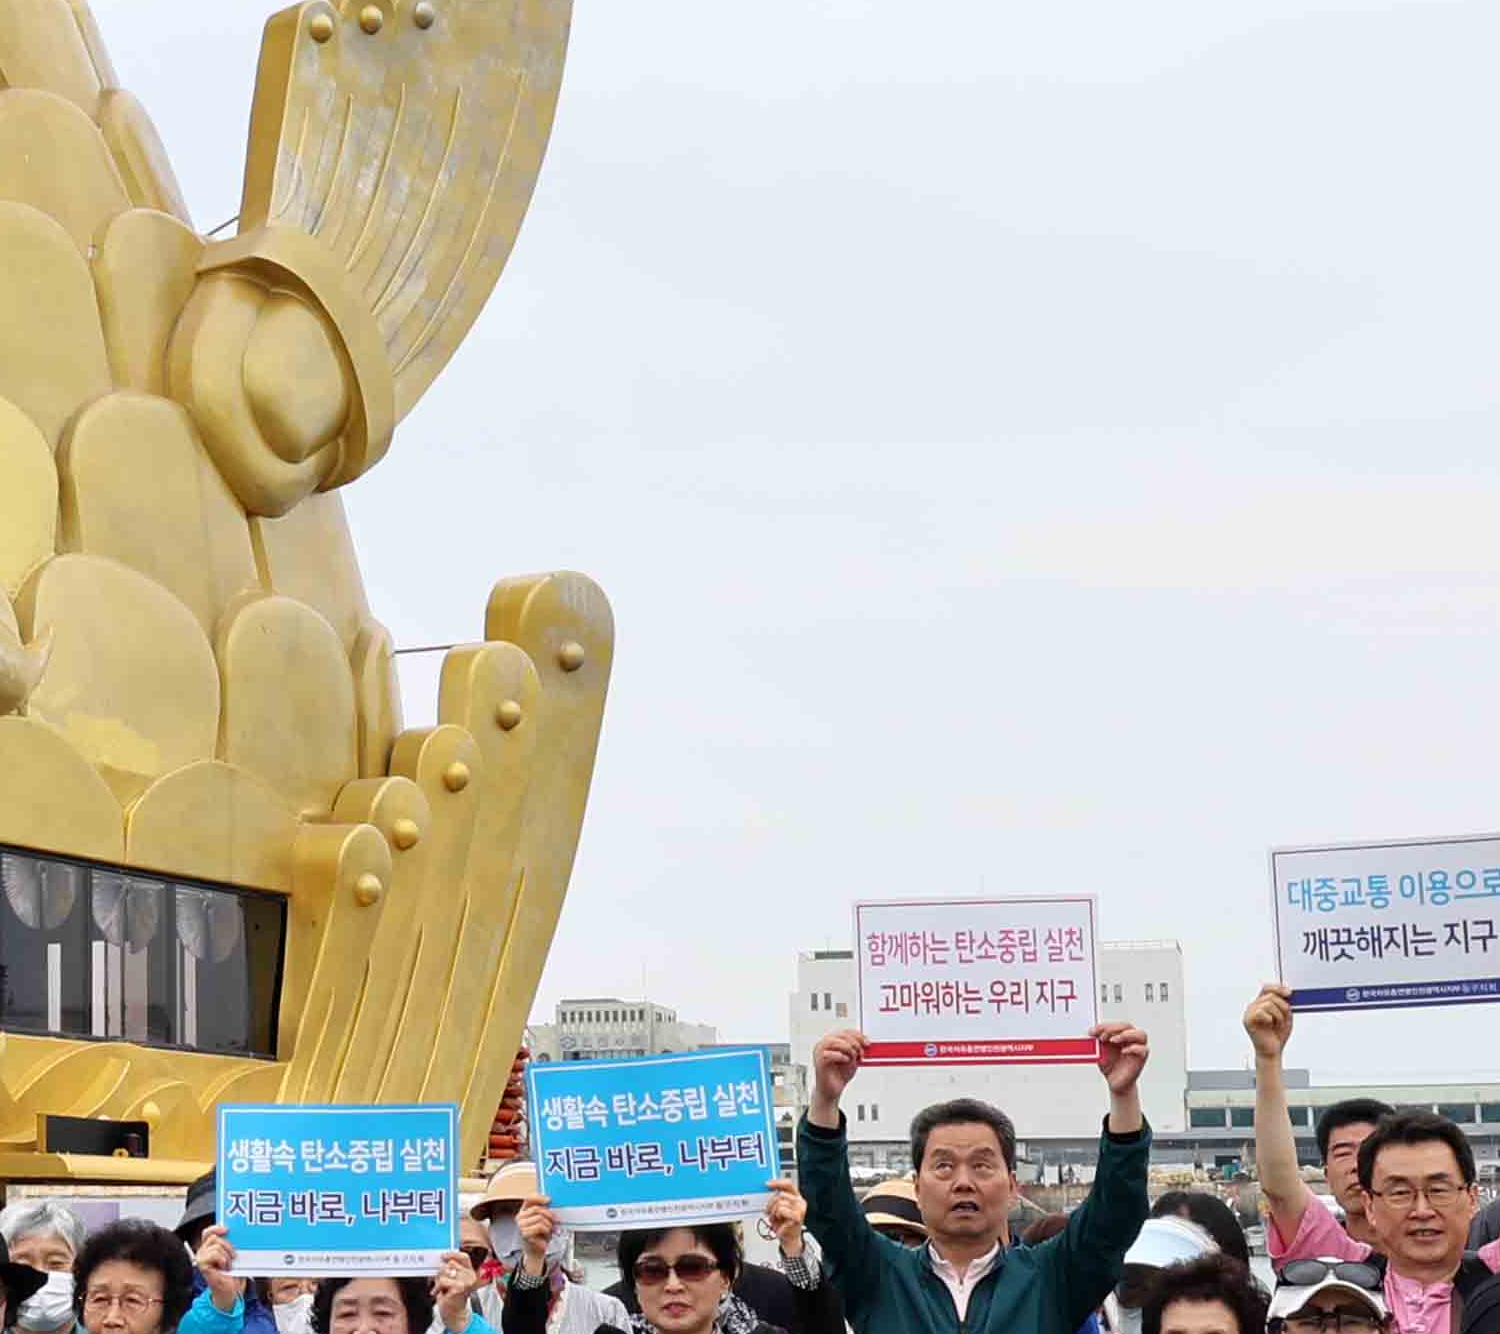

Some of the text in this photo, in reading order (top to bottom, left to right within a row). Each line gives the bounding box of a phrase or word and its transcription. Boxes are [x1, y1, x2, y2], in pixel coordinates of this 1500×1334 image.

[1288, 875, 1391, 913] 대중교통
[866, 927, 1084, 967] 함께하는 탄소중립 실천
[1301, 919, 1498, 962] 깨끗해지는 지구
[879, 978, 1078, 1018] 고마워하는 우리 지구
[541, 1082, 760, 1132] 생활속 탄소중립 실천
[228, 1138, 446, 1176] 생활속 탄소중립 실천
[545, 1132, 765, 1181] 지금 바로, 나부터
[227, 1189, 446, 1227] 지금 바로, 나부터
